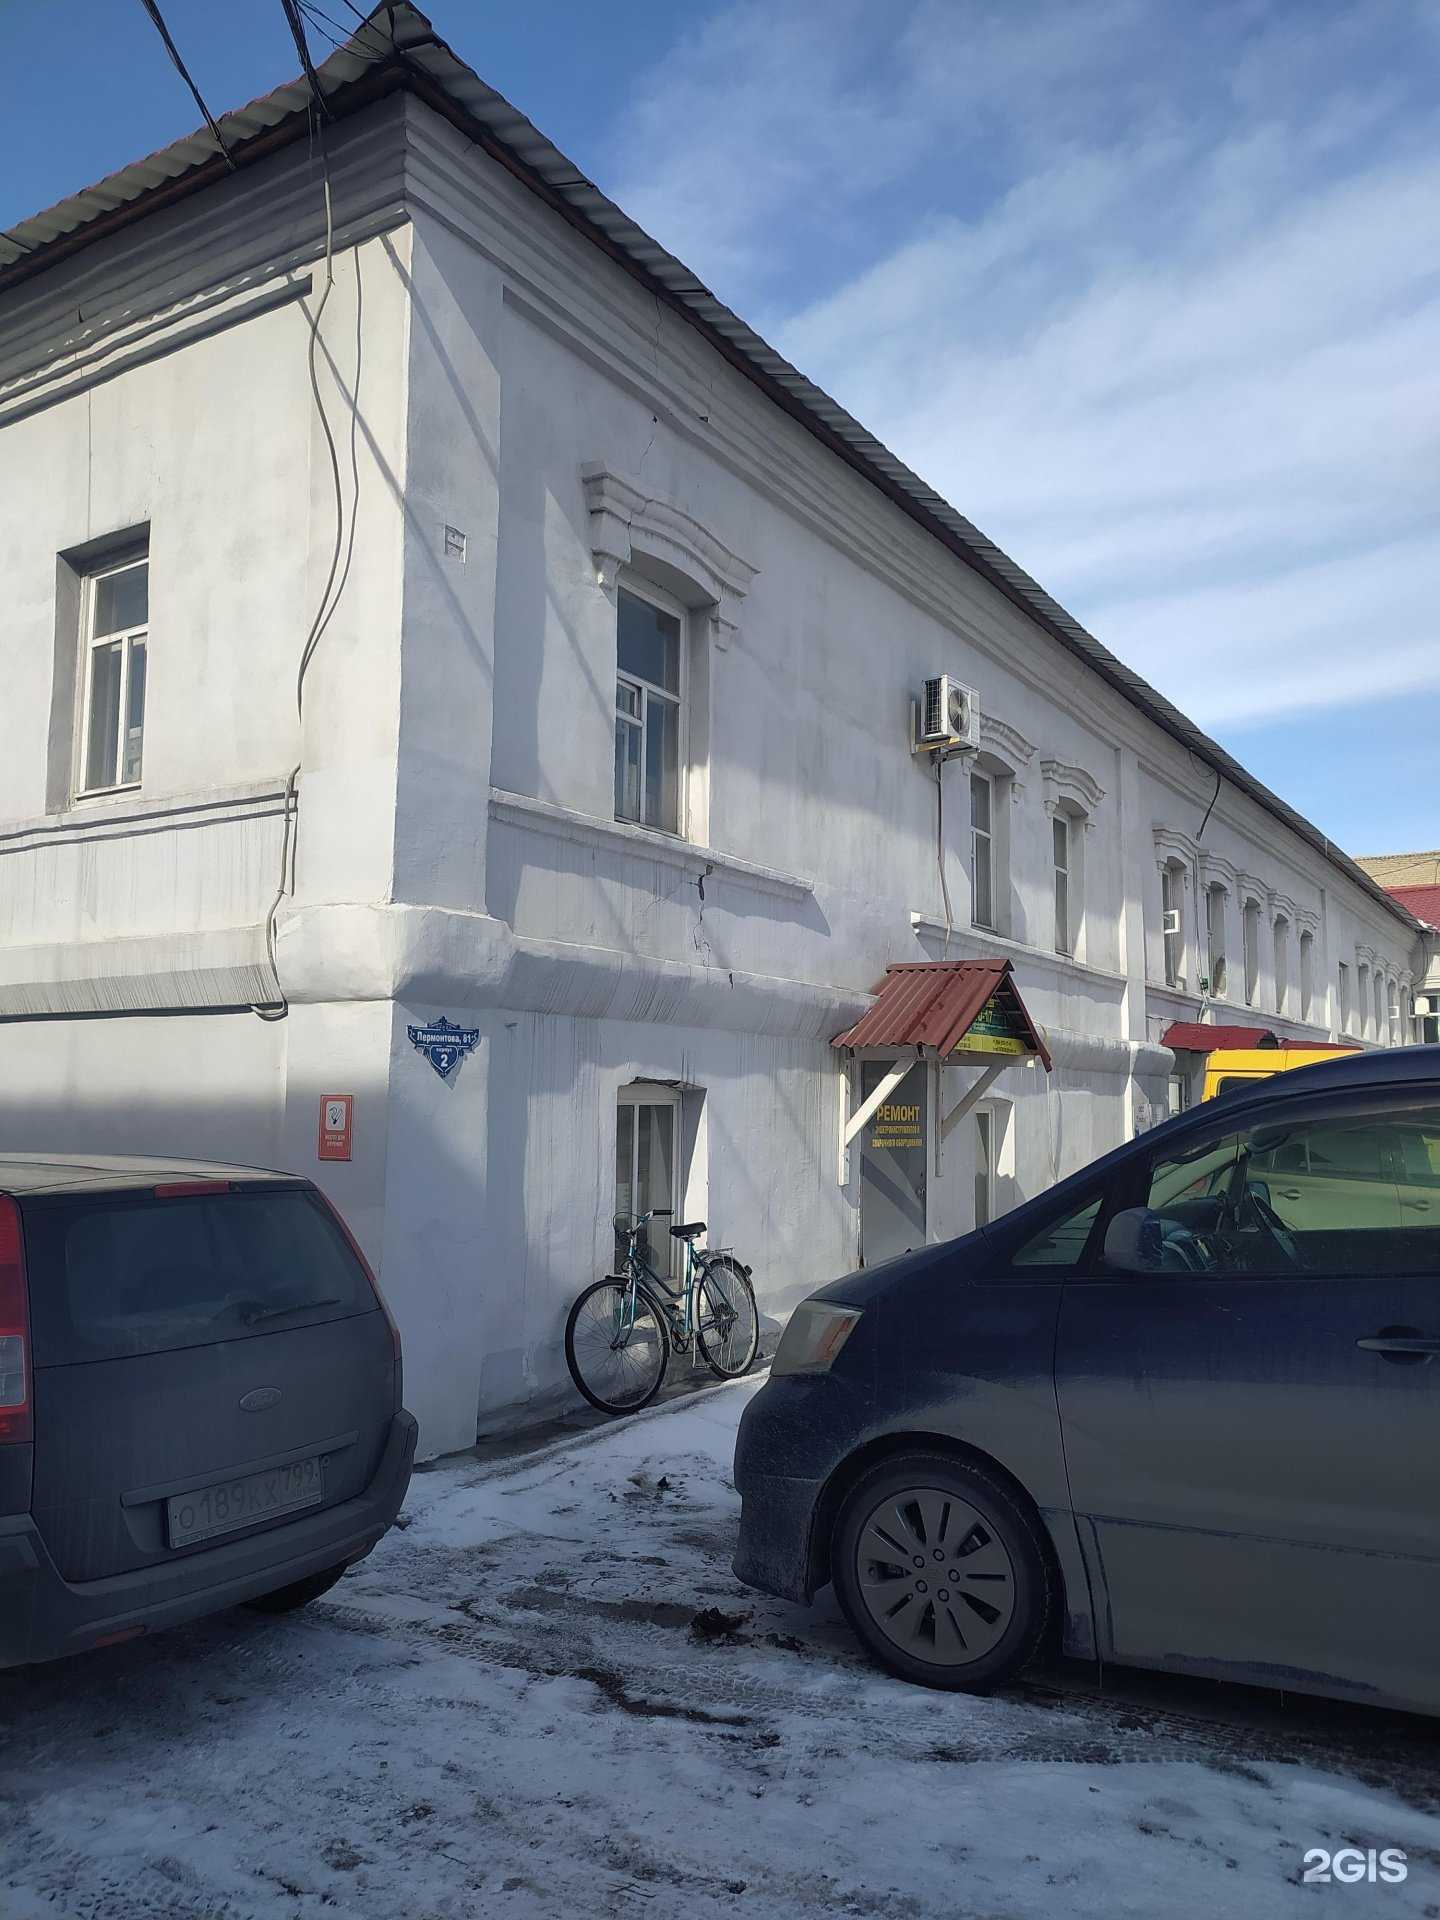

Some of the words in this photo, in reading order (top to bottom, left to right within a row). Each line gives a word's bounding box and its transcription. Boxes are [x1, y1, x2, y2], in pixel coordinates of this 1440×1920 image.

[416, 1031, 461, 1045] Лермонтова,
[462, 1034, 471, 1044] 81
[440, 1054, 448, 1067] 2
[876, 1105, 920, 1122] РЕМОНТ
